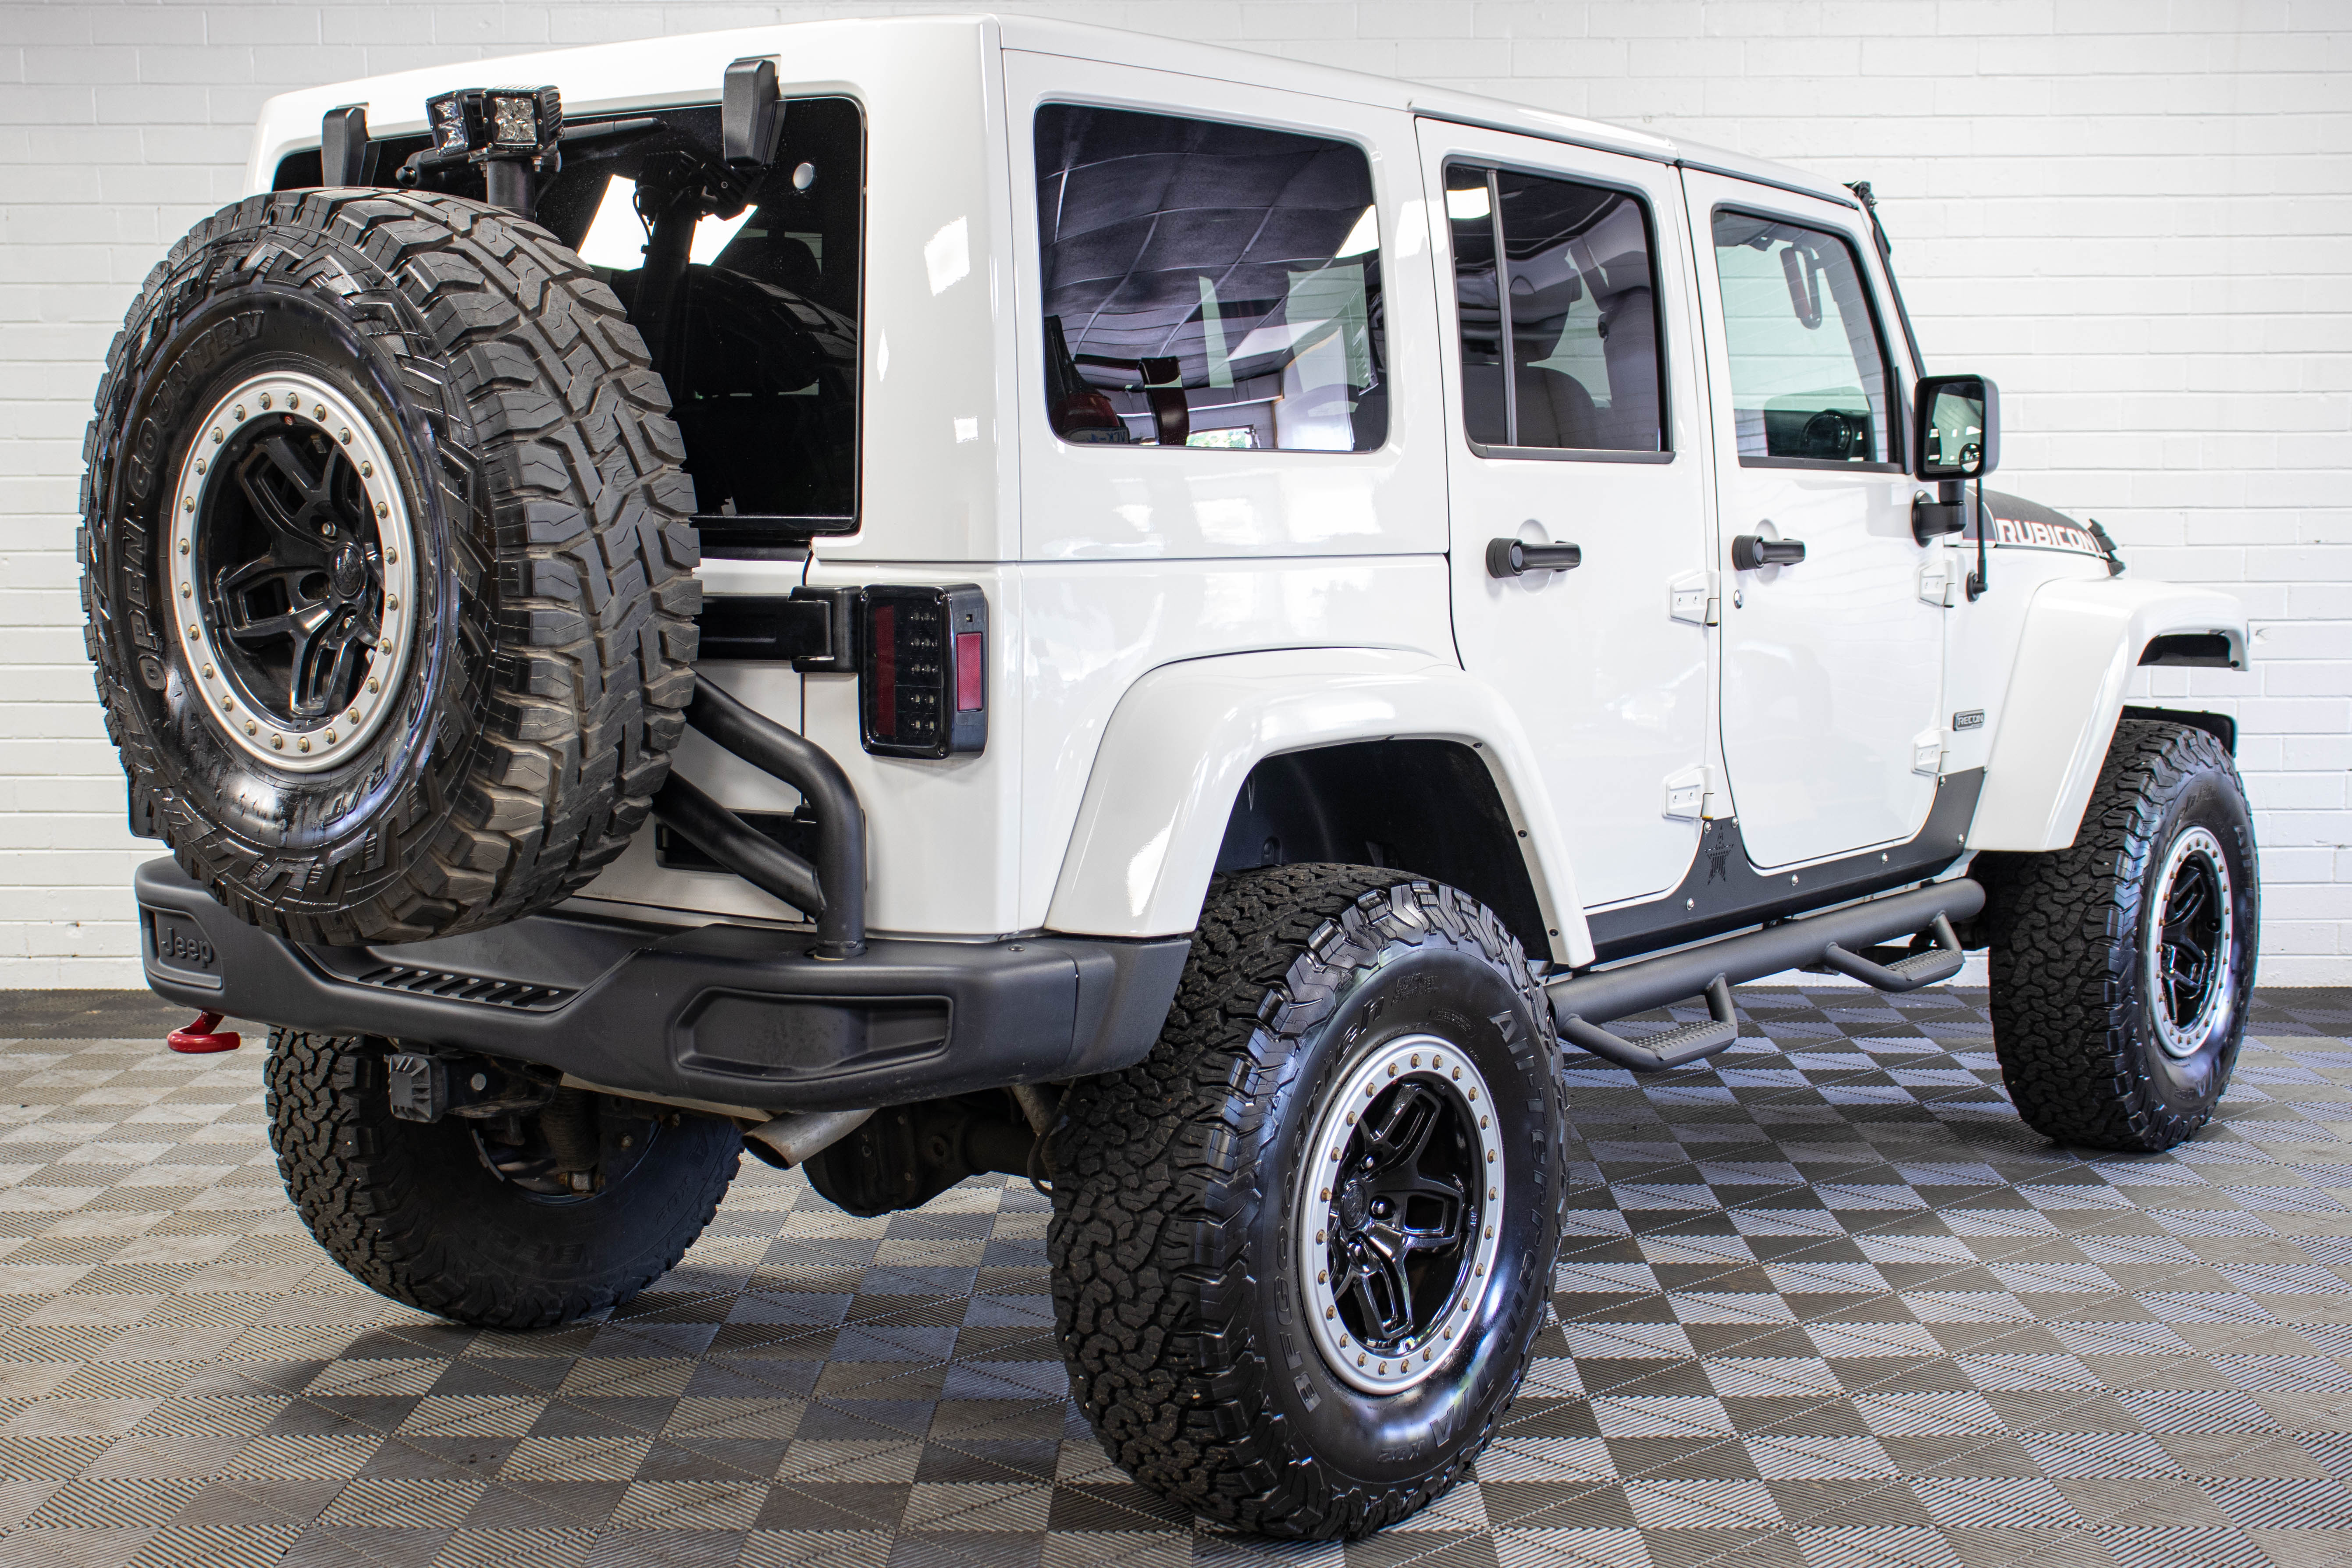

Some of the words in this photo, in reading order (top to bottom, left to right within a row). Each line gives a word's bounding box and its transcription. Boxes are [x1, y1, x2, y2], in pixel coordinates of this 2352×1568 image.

[128, 309, 264, 498] COUNTRY
[1996, 518, 2103, 553] RUBICON
[124, 516, 167, 691] OPEN
[1957, 715, 1984, 725] RECON
[322, 746, 390, 827] R/T
[161, 928, 215, 969] Jeep
[1274, 996, 1384, 1413] BFGoodrich
[1490, 1011, 1548, 1355] All-Terrain
[1430, 1369, 1493, 1447] T/A
